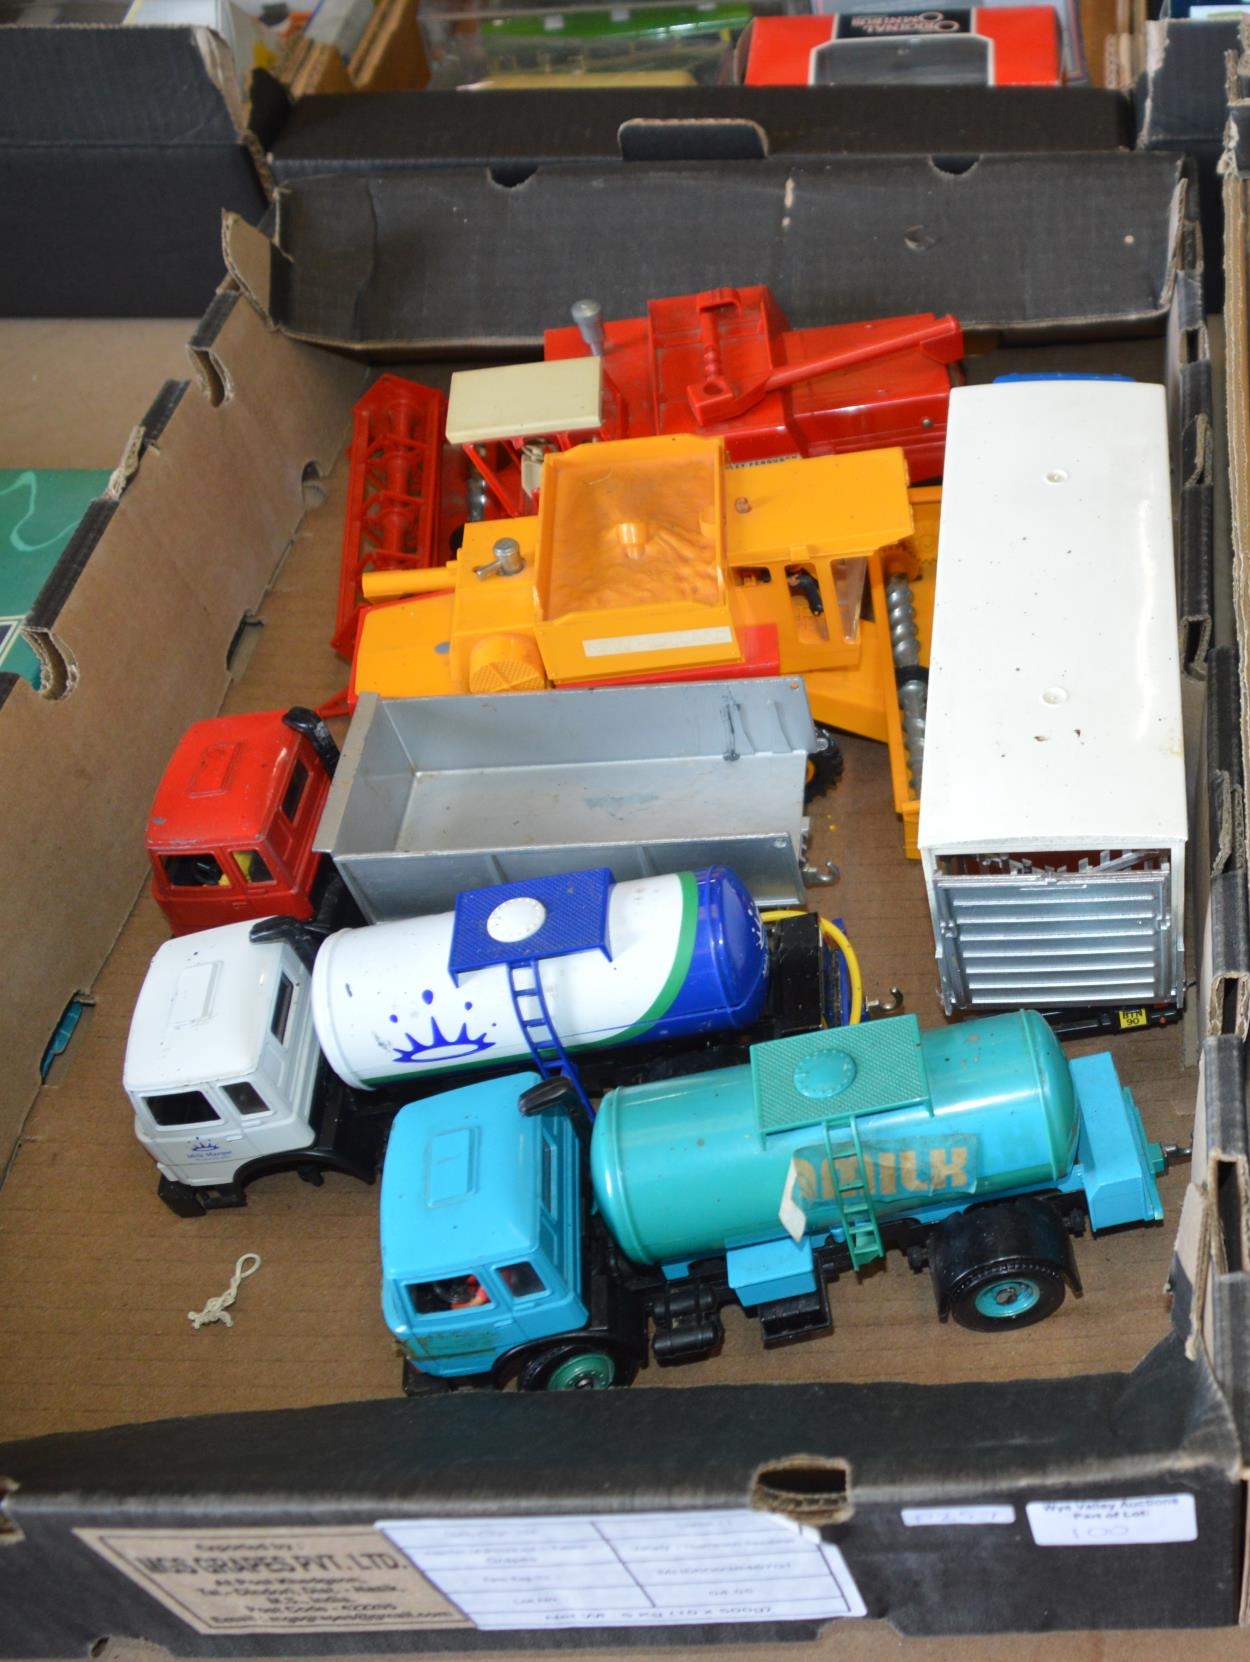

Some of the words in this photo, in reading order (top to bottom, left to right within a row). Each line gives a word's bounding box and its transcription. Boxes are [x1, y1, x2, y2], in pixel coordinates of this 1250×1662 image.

[1076, 1502, 1113, 1512] Valley
[193, 1556, 296, 1575] GRAPES
[293, 1554, 353, 1572] PVT.
[347, 1553, 408, 1571] LTD.
